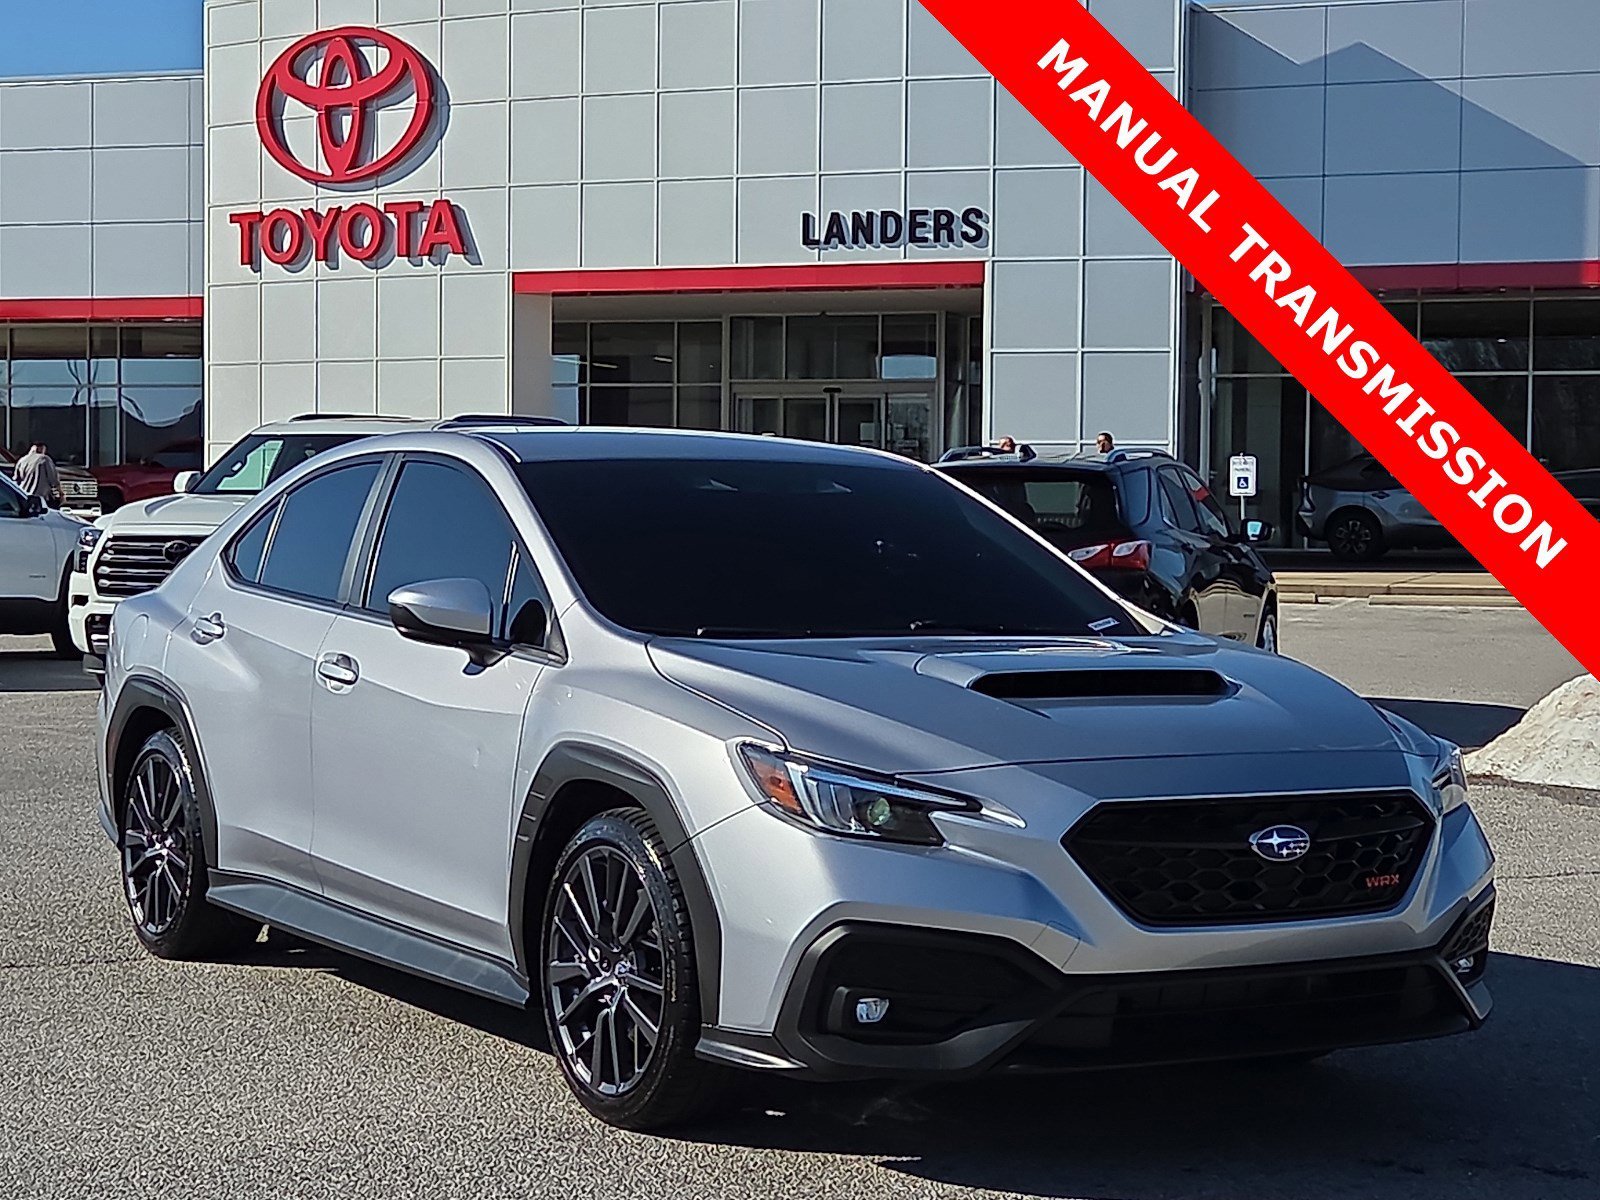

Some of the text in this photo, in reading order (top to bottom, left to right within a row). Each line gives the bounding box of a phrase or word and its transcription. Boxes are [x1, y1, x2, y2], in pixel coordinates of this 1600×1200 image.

[229, 199, 469, 266] TOYOTA
[801, 207, 985, 246] LANDERS
[1365, 873, 1400, 888] WRX
